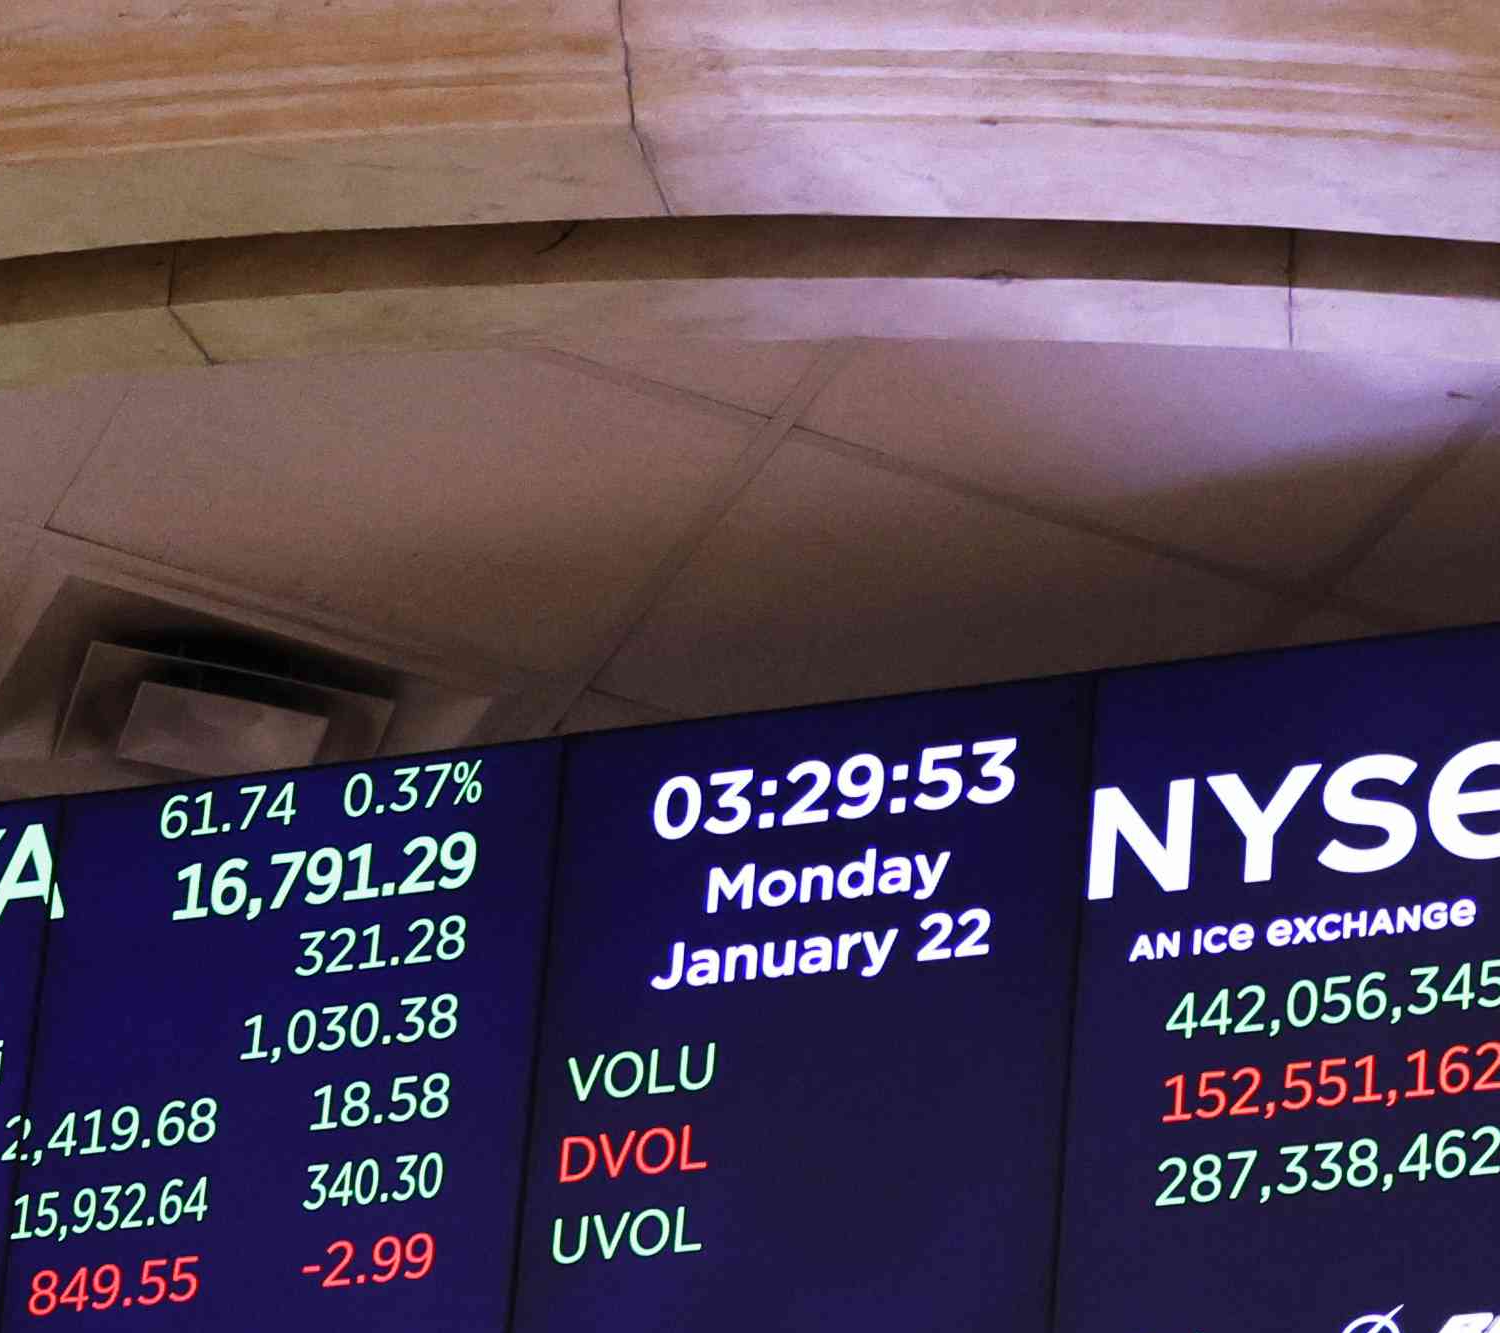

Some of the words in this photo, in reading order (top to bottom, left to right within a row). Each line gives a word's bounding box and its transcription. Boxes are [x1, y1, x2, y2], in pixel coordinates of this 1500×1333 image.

[161, 782, 296, 839] 61.74
[344, 760, 482, 817] 0.37%
[654, 738, 1016, 839] 03:29:53
[173, 823, 476, 920] 16,791.29
[707, 848, 950, 913] Monday
[295, 915, 466, 976] 321.28
[651, 928, 898, 990] January
[917, 908, 990, 961] 22
[1129, 931, 1180, 962] AN
[240, 994, 458, 1063] 1,030.38
[568, 1043, 715, 1101] VOLU
[1, 1098, 217, 1166] 2,419.68
[310, 1073, 449, 1130] 18.58
[559, 1125, 708, 1183] DVOL
[11, 1176, 207, 1241] 15,932.64
[303, 1152, 443, 1210] 340.30
[553, 1206, 701, 1264] UVOL
[1155, 1126, 1500, 1206] 287,338,462
[28, 1256, 199, 1316] 849.55
[302, 1232, 436, 1288] -2.99
